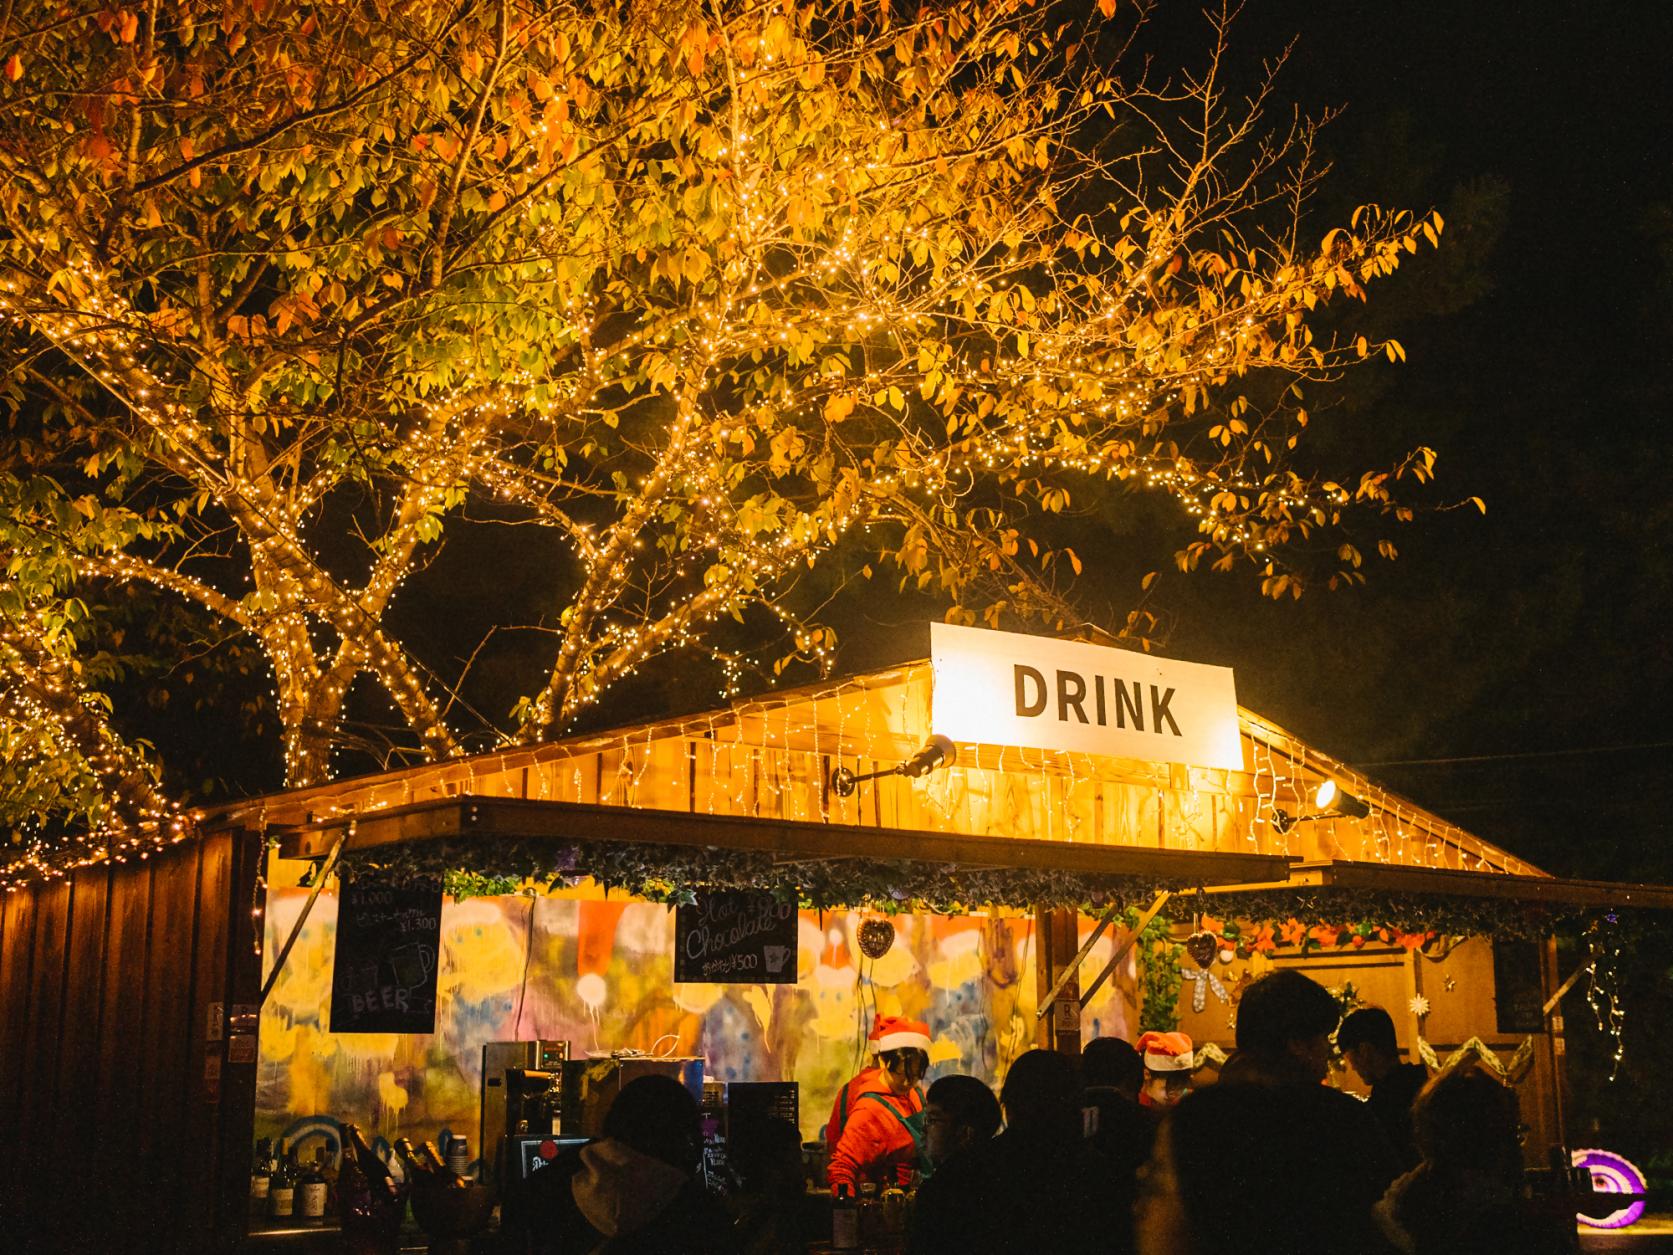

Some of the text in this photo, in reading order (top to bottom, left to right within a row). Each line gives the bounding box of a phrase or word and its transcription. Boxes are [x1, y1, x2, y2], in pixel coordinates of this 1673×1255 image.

[1014, 664, 1182, 737] DRINK
[697, 897, 735, 926] Hot
[687, 911, 776, 959] Chocolate
[352, 986, 408, 1013] BEER
